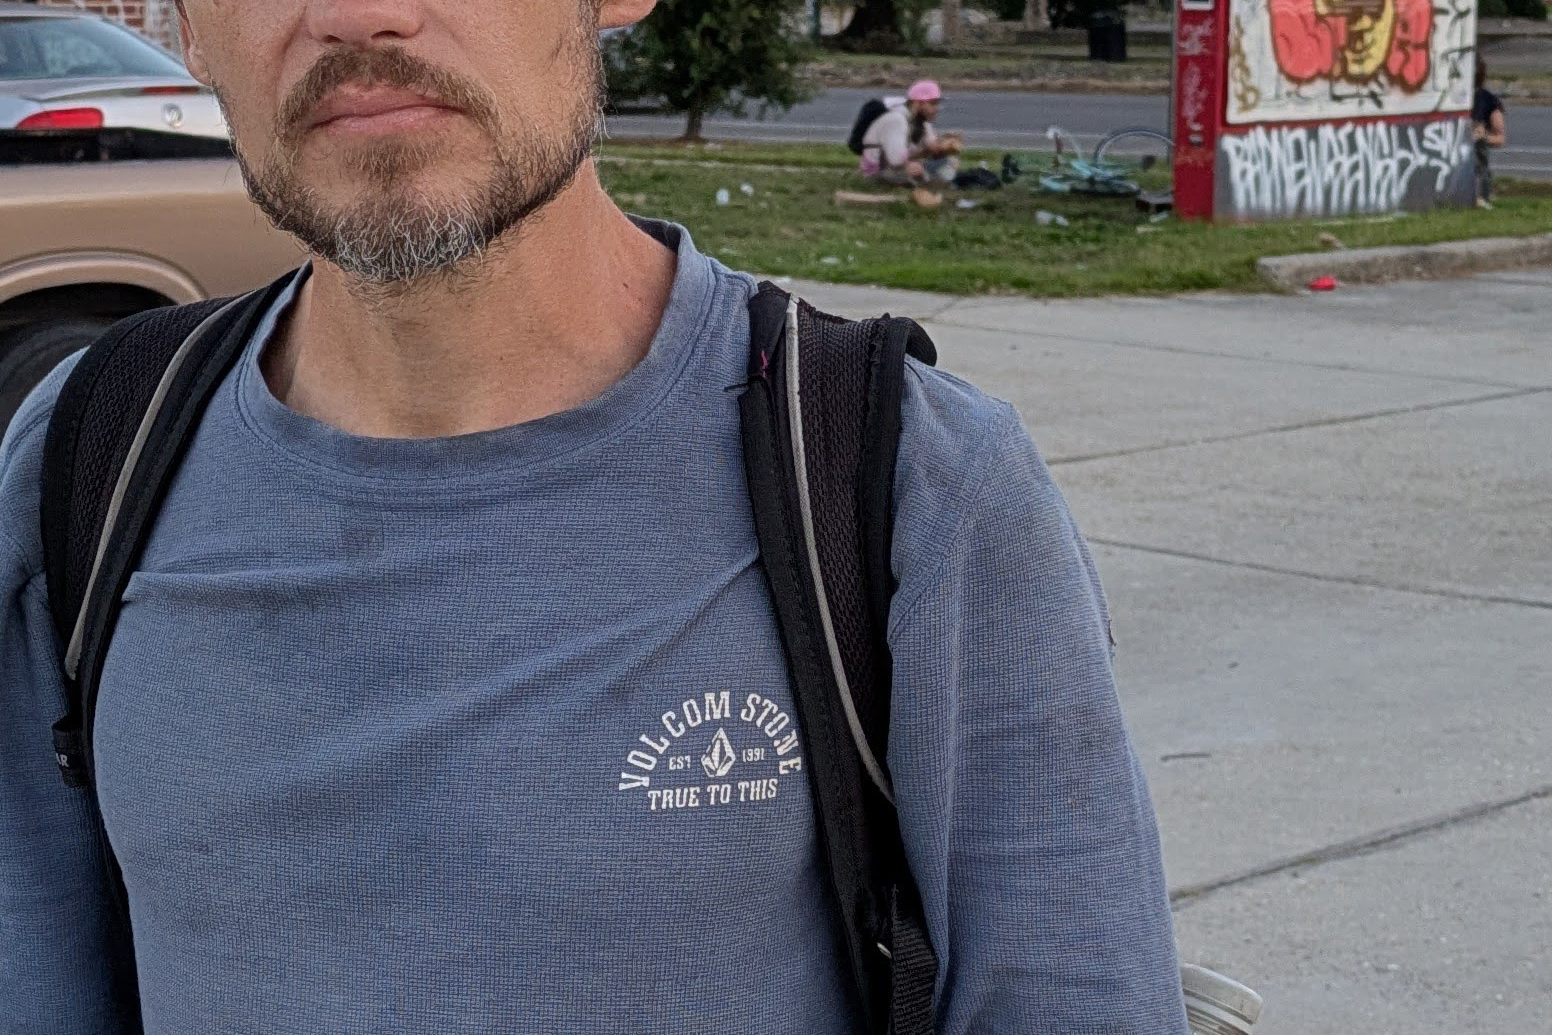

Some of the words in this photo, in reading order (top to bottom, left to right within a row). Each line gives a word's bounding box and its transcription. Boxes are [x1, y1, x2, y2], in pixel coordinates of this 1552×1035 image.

[618, 690, 732, 791] VOLCOM
[740, 692, 802, 775] STONE
[742, 747, 766, 763] 1991
[648, 786, 701, 811] TRUE
[706, 783, 732, 805] TO
[737, 778, 779, 802] THIS
